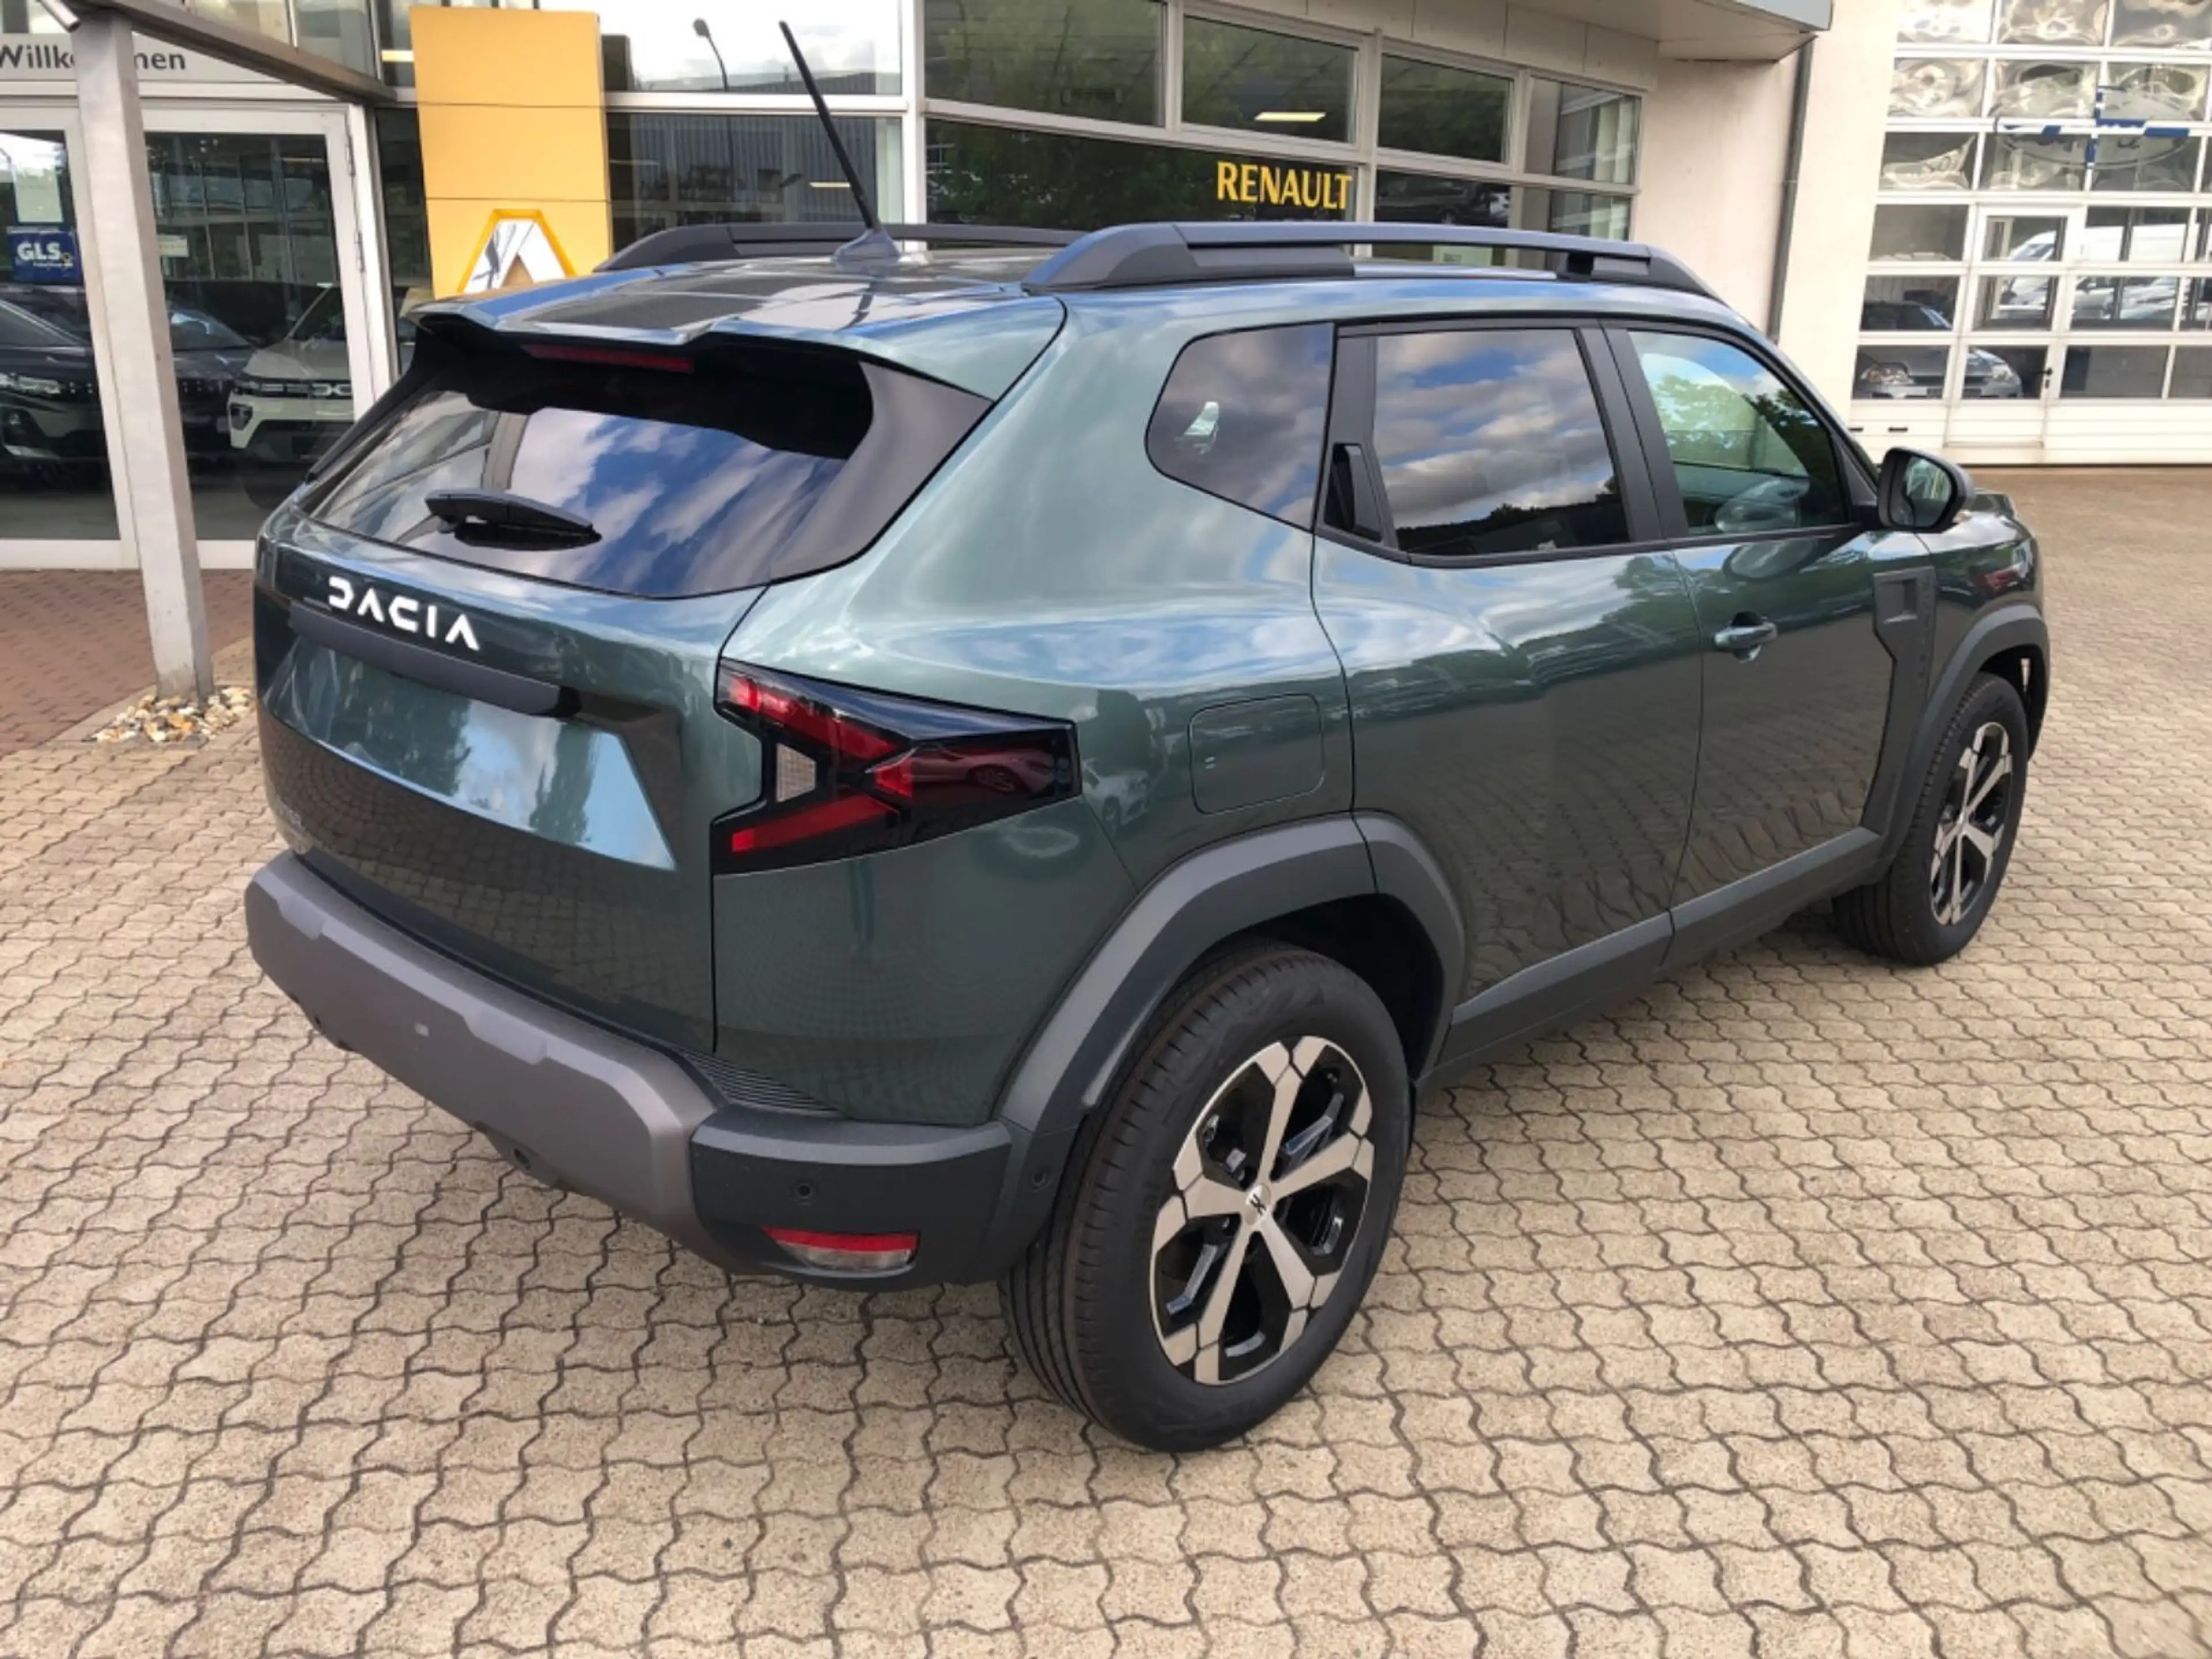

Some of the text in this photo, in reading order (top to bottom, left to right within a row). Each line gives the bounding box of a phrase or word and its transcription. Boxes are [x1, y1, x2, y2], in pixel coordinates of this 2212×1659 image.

[1217, 161, 1352, 210] RENAULT
[17, 241, 60, 261] GLS
[328, 575, 480, 652] DACIA
